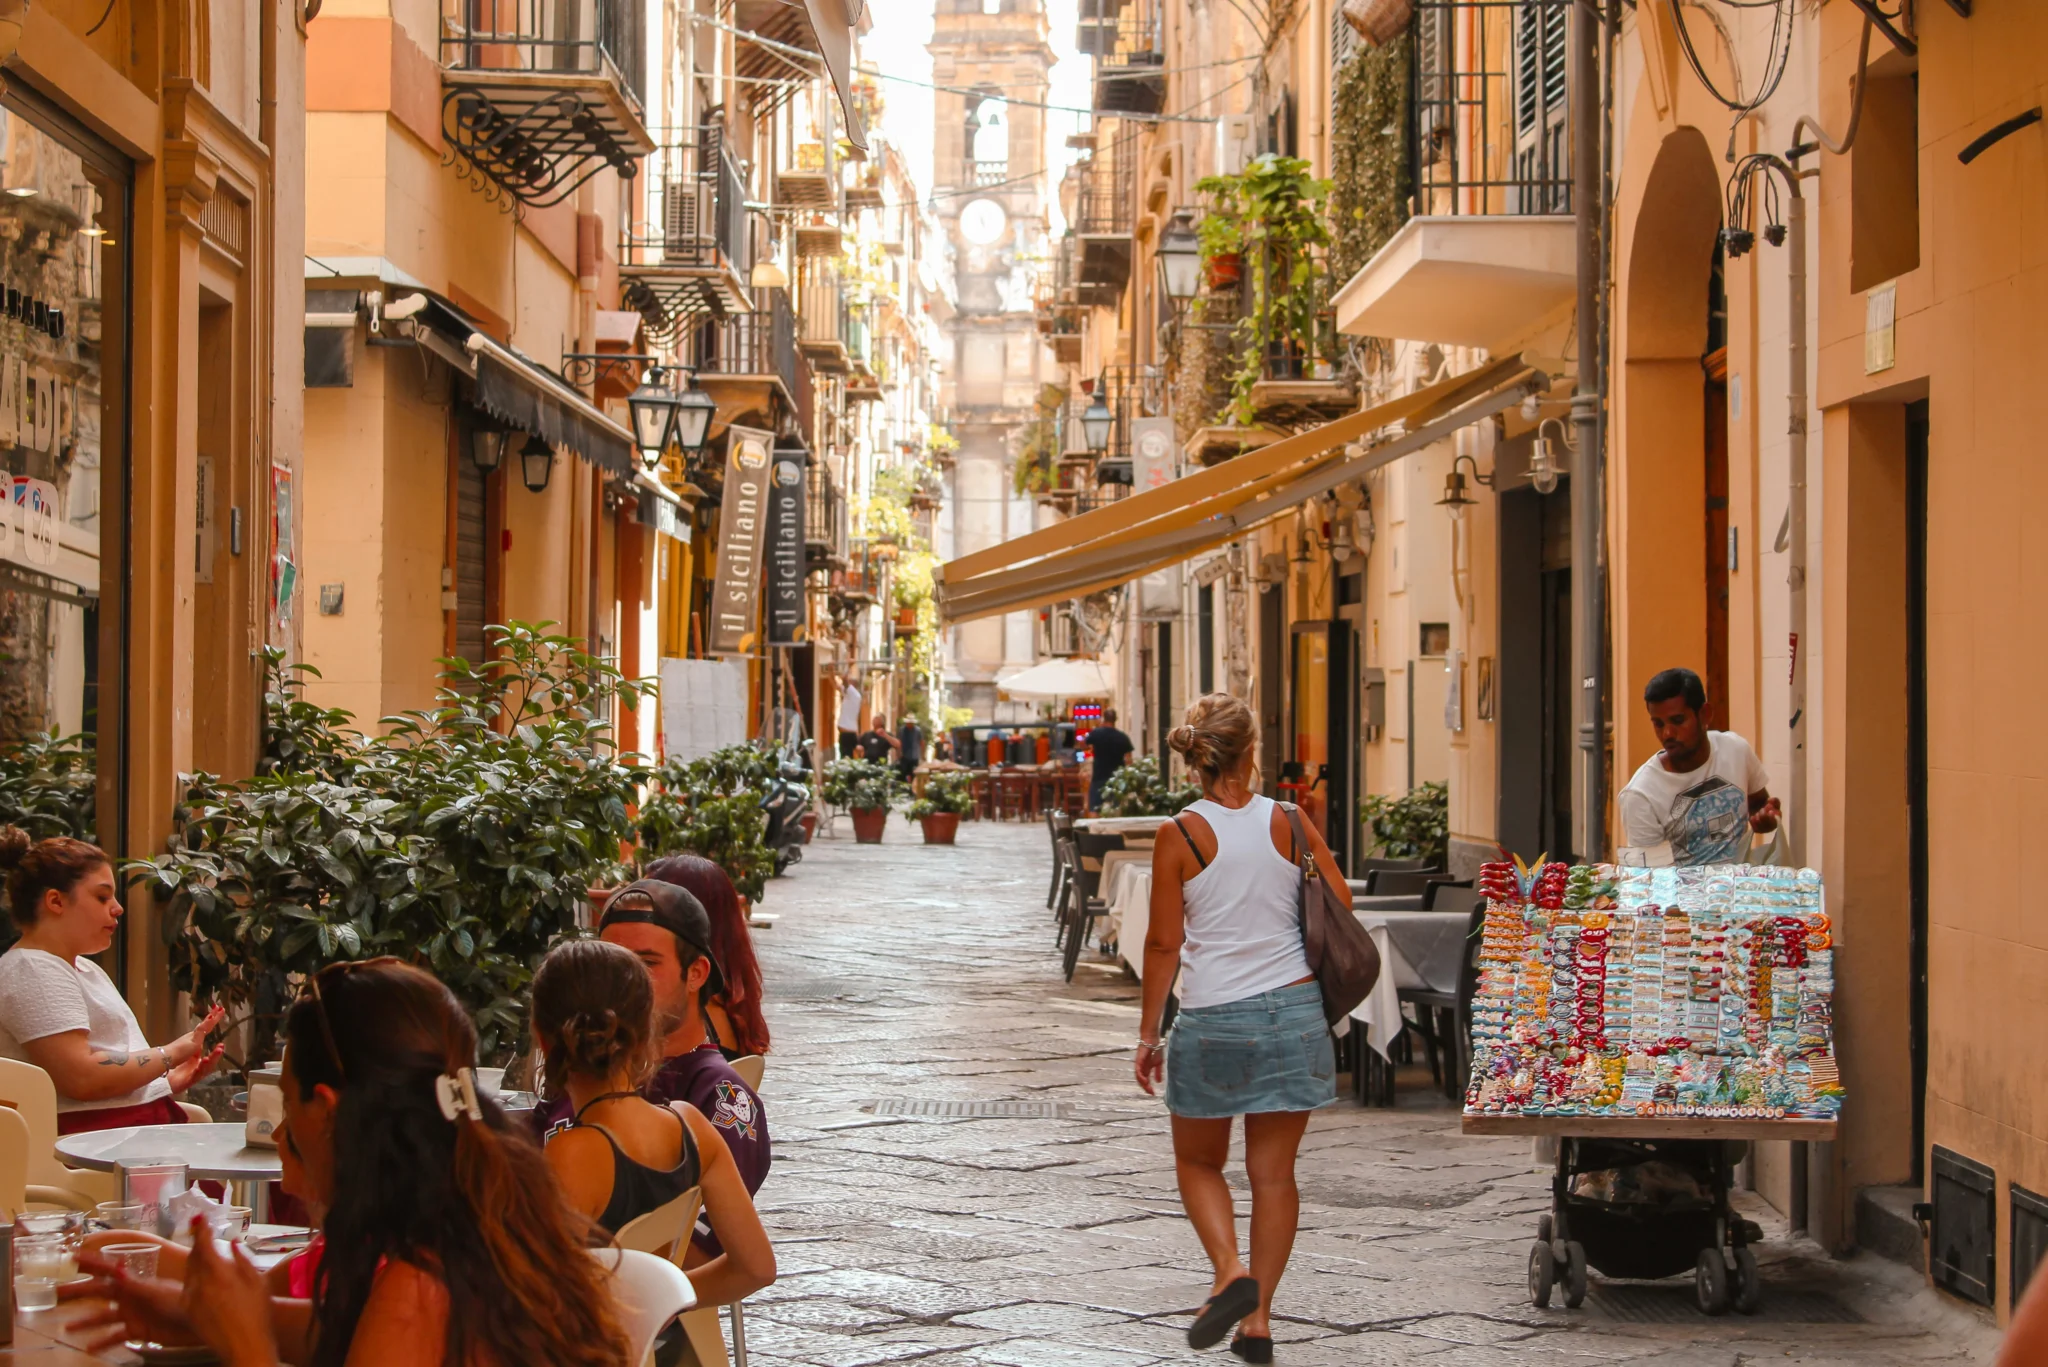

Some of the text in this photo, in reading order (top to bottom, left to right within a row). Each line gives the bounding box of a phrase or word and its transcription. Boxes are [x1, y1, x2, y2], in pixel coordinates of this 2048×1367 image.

[0, 283, 64, 339] BANO
[726, 482, 758, 603] siciliano
[775, 497, 797, 600] siciliano
[720, 613, 746, 632] il
[775, 609, 797, 625] il
